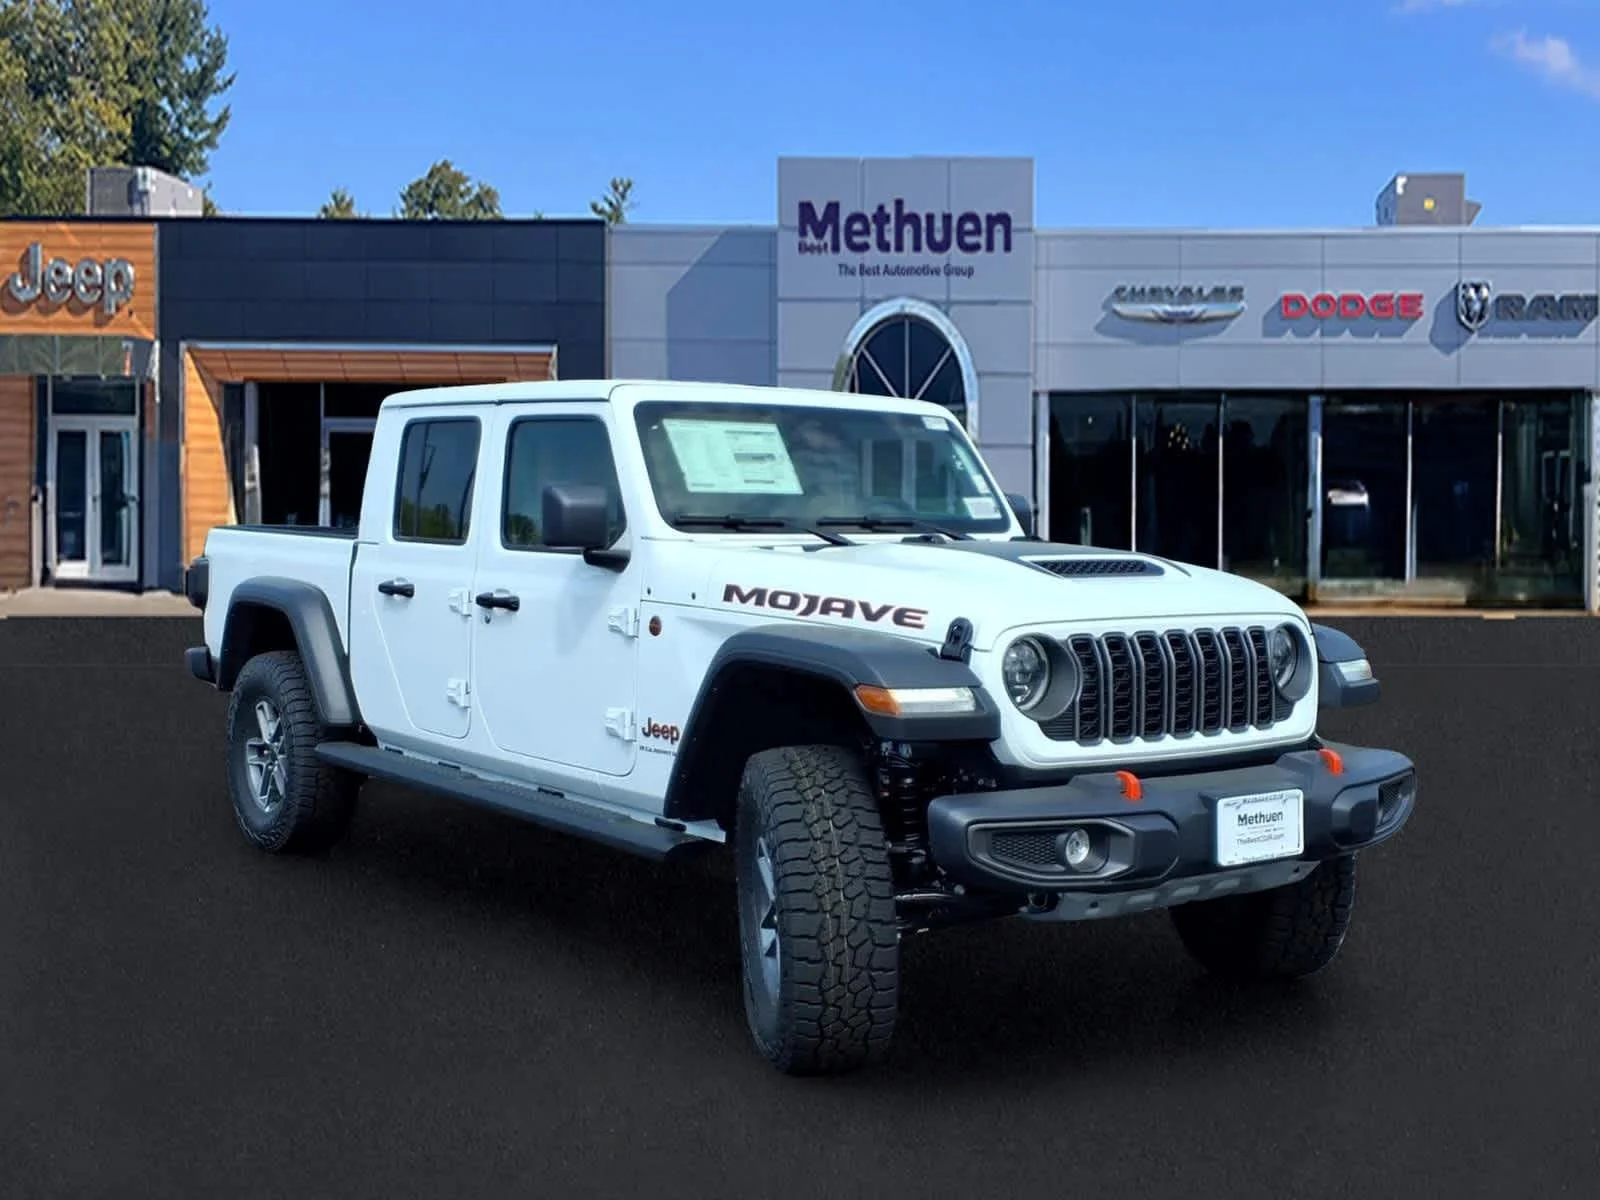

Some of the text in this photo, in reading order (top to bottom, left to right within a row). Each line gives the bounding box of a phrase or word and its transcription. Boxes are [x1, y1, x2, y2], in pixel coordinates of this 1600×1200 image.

[798, 198, 1012, 253] Methuen
[9, 242, 134, 314] Jeep
[837, 264, 975, 279] The Best Automotive Group
[1281, 293, 1424, 318] DODGE
[1495, 294, 1599, 320] RAM
[723, 584, 928, 629] MOJAVE
[641, 717, 680, 745] Jeep
[1237, 811, 1284, 825] Methuen
